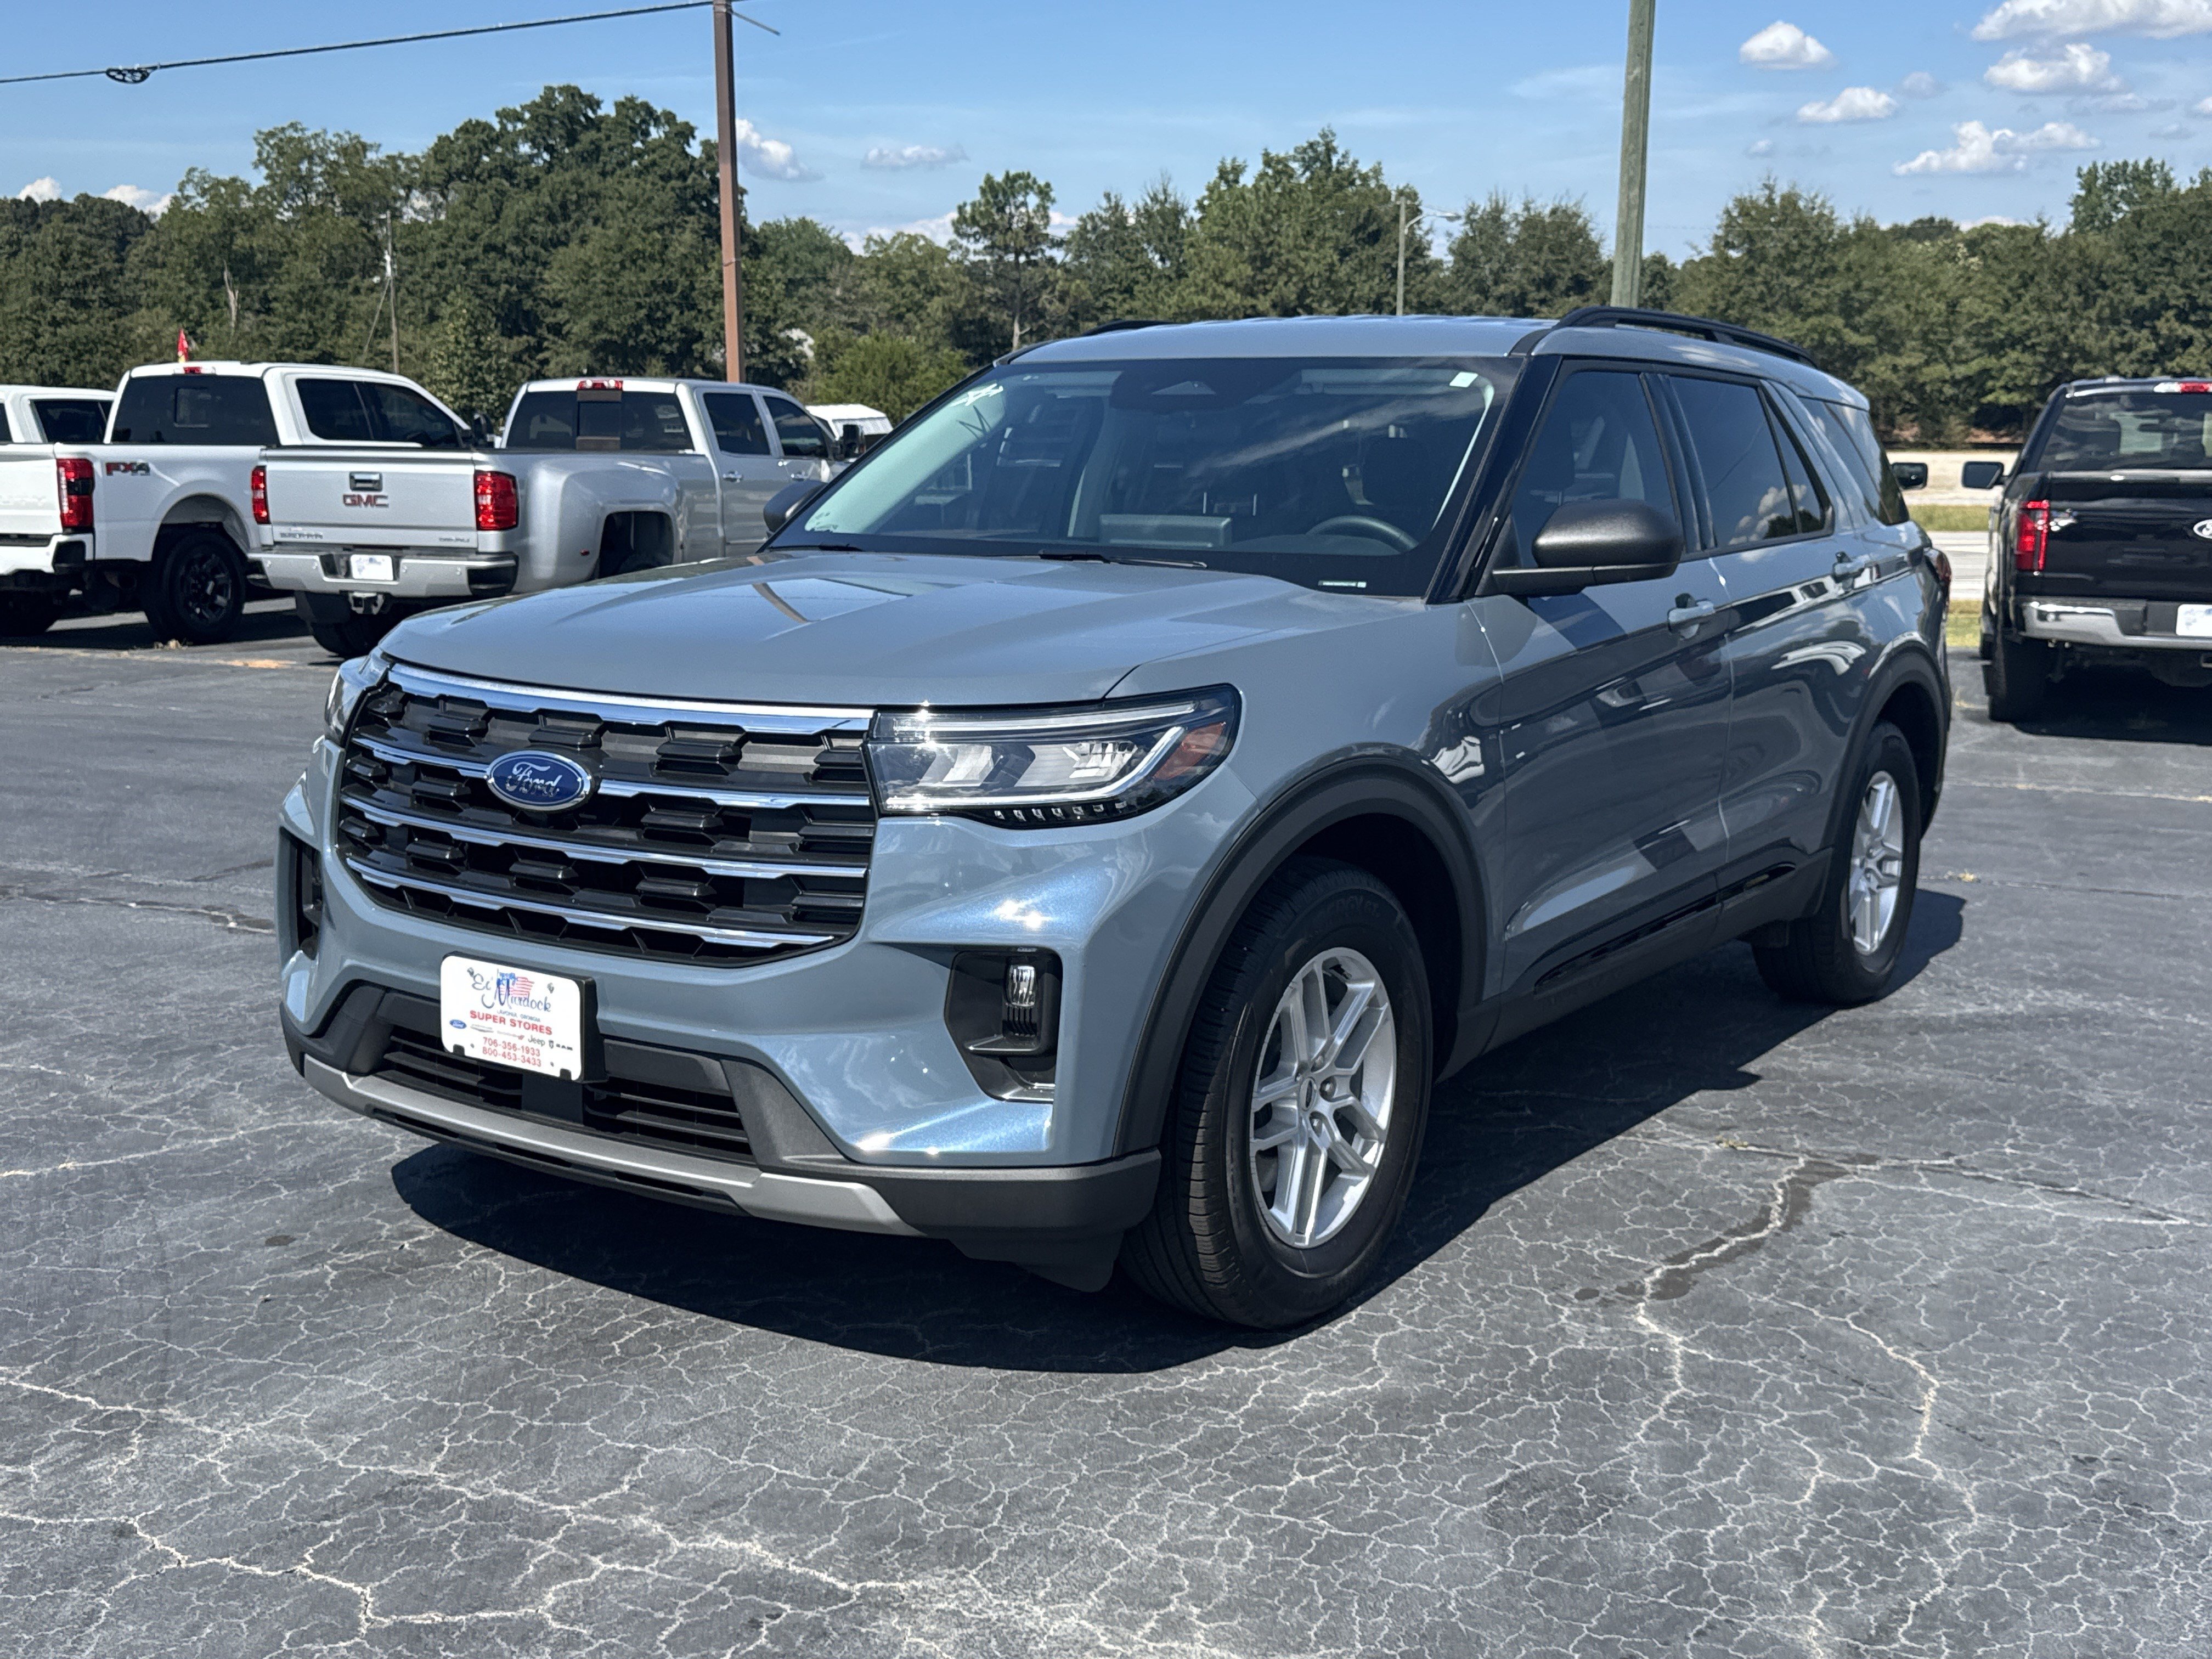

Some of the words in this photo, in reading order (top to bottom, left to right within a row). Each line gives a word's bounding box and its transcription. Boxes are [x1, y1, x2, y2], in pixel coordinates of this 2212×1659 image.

[105, 462, 151, 476] FX4
[343, 494, 389, 507] GMC
[505, 761, 563, 797] Ford
[481, 978, 551, 1012] Murdock
[470, 1010, 506, 1025] SUPER
[510, 1018, 552, 1035] STORES
[483, 1036, 540, 1057] 706-356-1933
[528, 1035, 546, 1047] Jeep
[482, 1046, 541, 1067] 800-453-3433
